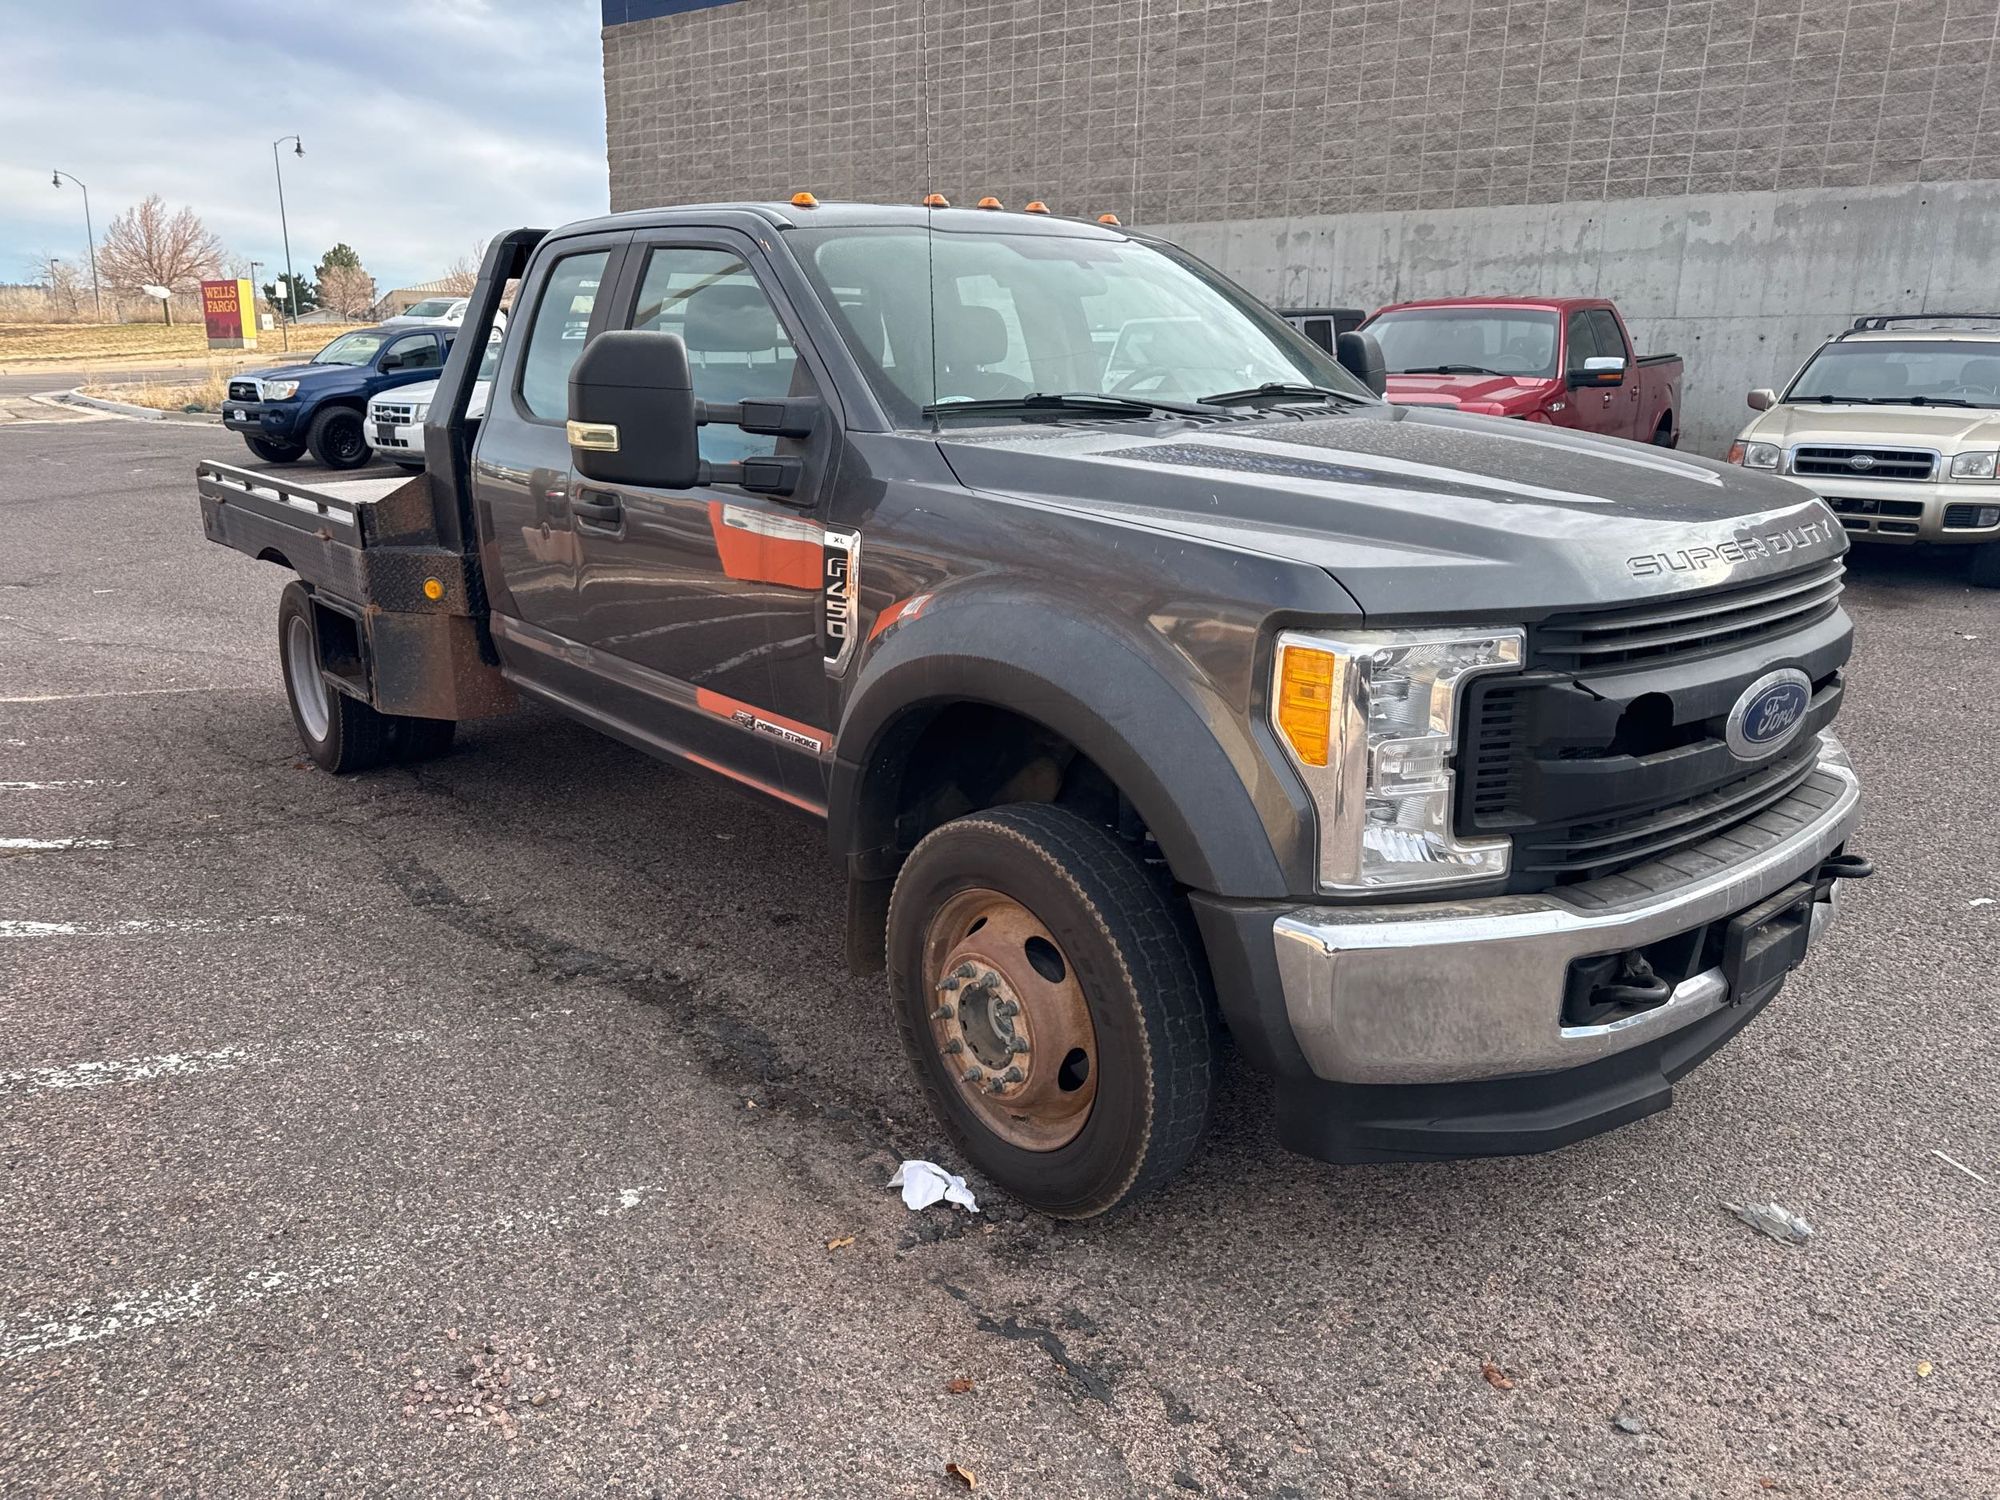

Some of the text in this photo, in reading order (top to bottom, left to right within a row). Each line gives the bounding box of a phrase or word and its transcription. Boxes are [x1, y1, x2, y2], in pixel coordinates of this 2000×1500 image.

[204, 286, 236, 299] WELLS
[207, 300, 237, 313] FARGO
[833, 536, 845, 545] XL
[1625, 519, 1832, 577] SUPER DUTY
[1757, 692, 1799, 736] Ford
[756, 721, 818, 750] POWER STROKE
